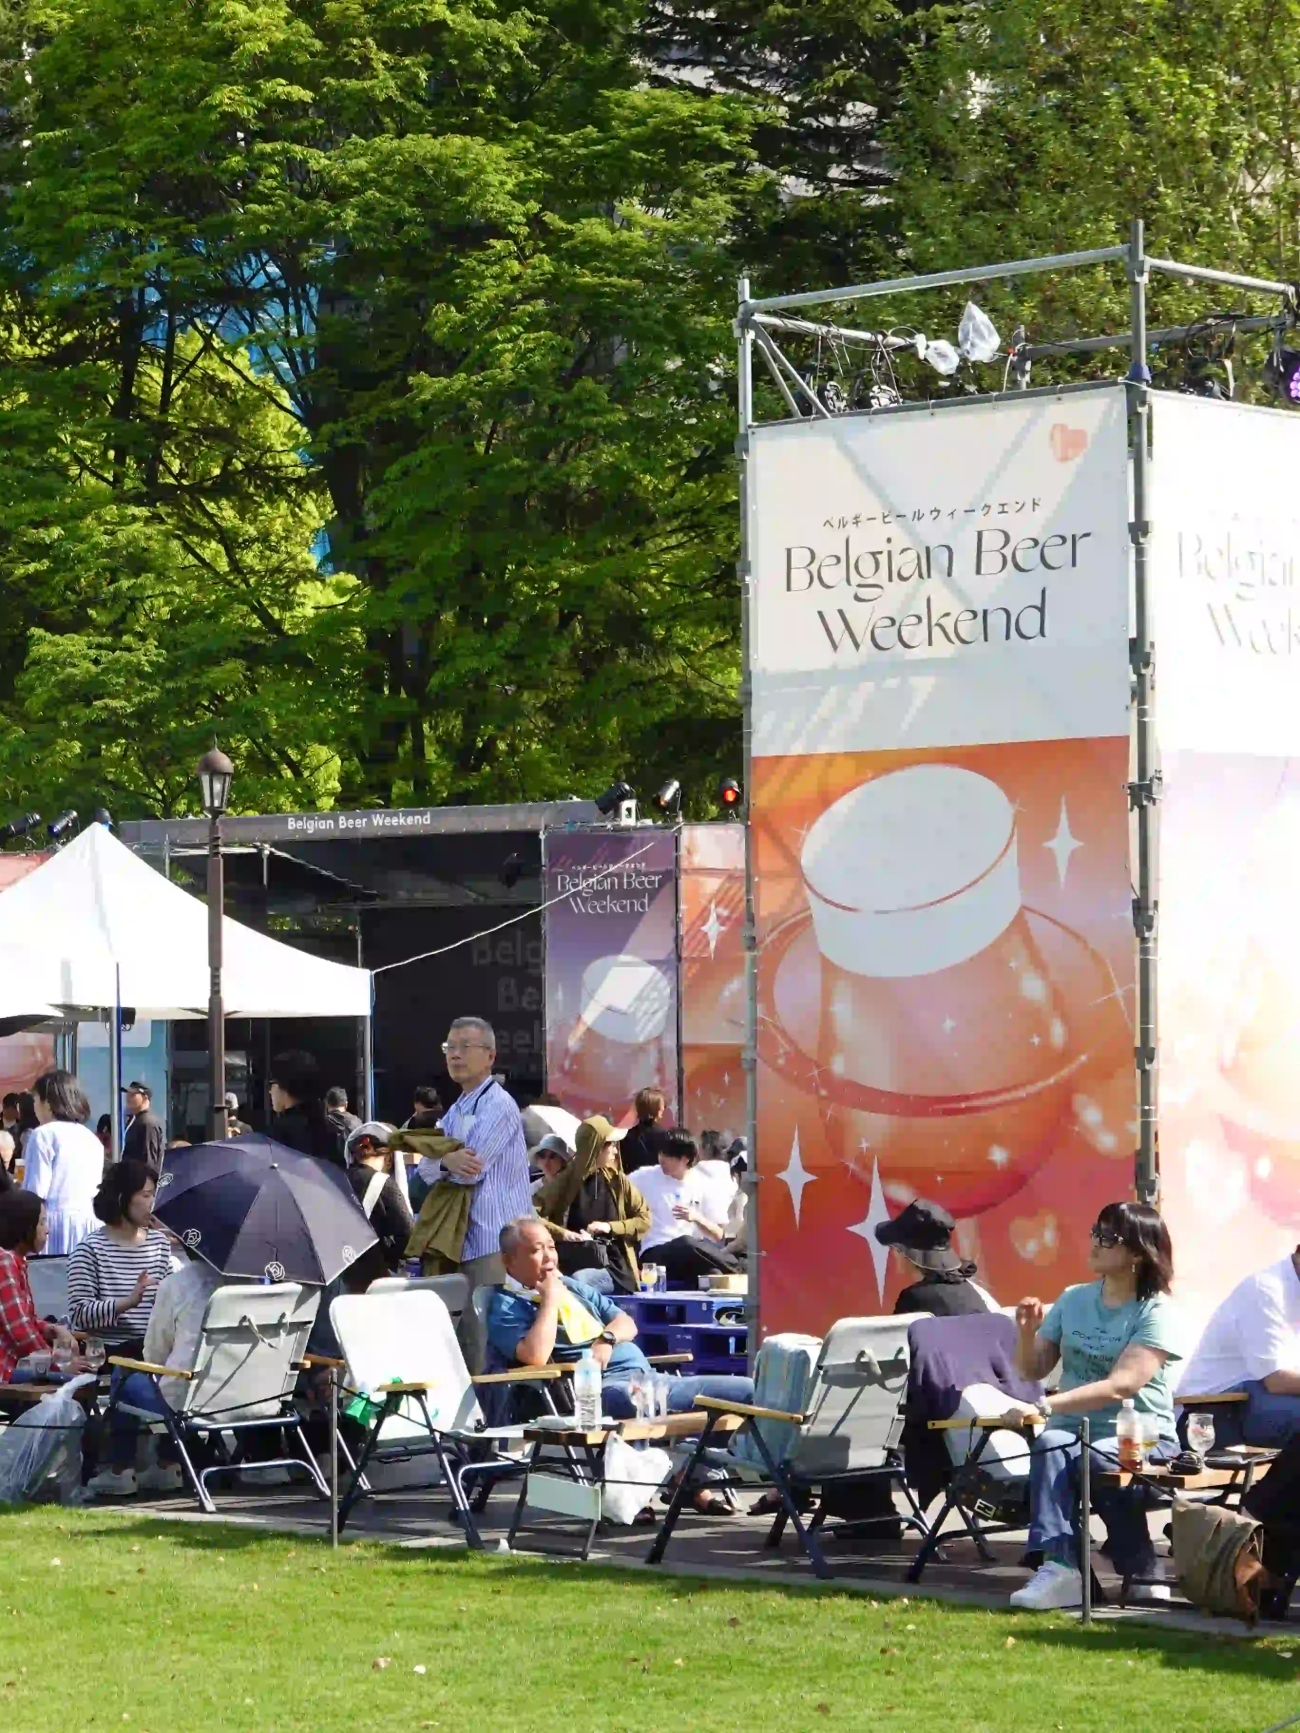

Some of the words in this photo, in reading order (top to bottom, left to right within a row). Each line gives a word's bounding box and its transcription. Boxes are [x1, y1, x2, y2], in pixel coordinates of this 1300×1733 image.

[822, 497, 1042, 529] ベルギービールウィークエンド
[785, 536, 954, 603] Belgian
[975, 528, 1092, 576] Beer
[817, 586, 1048, 653] Weekend
[287, 817, 334, 834] Belgian
[338, 814, 368, 829] Beer
[371, 811, 432, 826] Weekend
[557, 872, 619, 897] Belgian
[623, 872, 663, 890] Beer
[569, 892, 650, 914] Weekend
